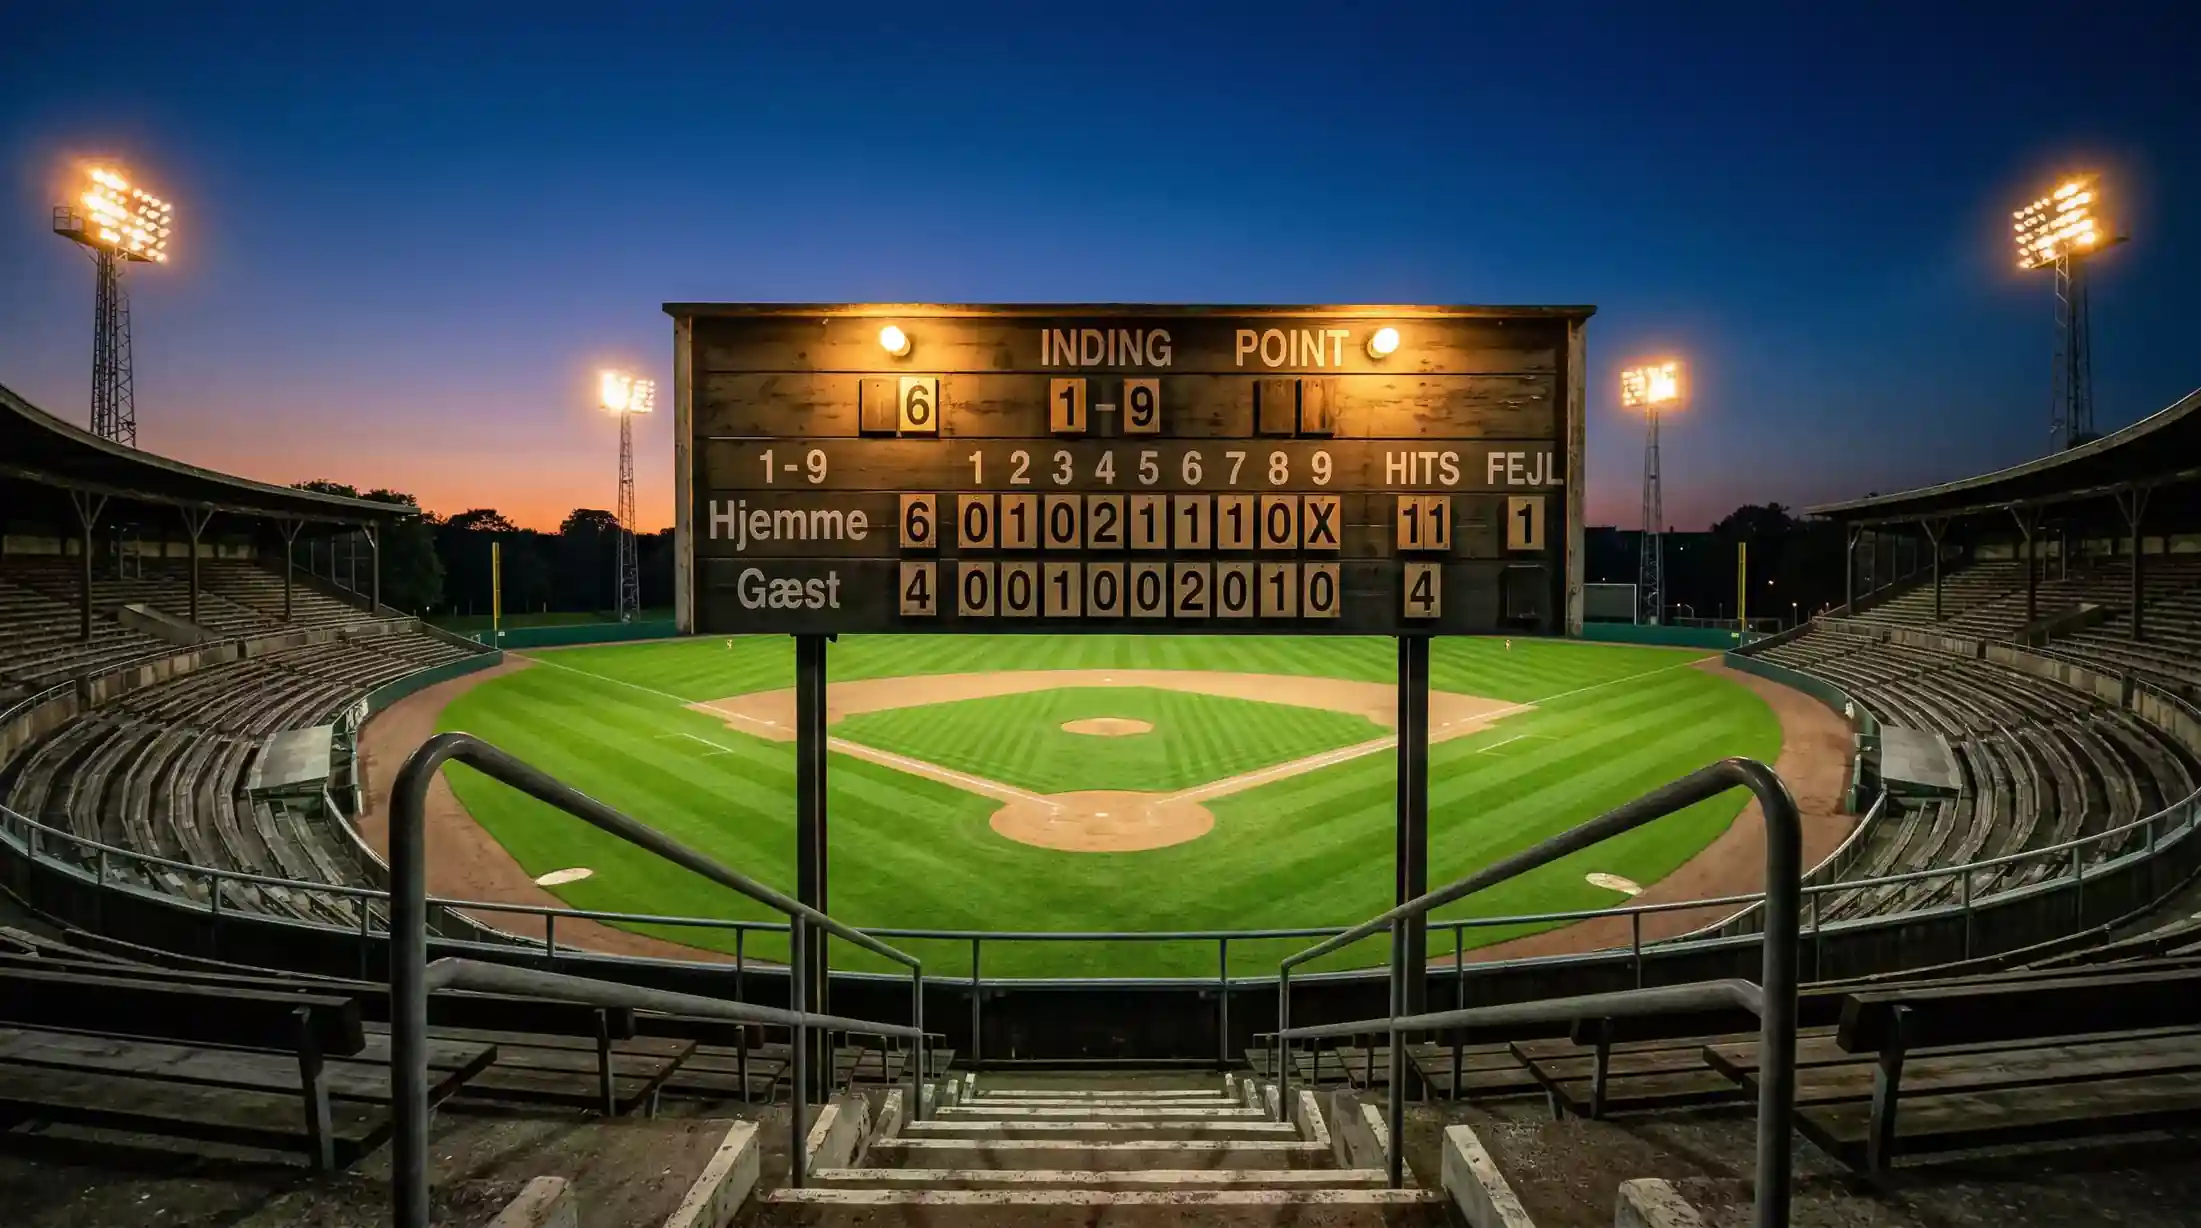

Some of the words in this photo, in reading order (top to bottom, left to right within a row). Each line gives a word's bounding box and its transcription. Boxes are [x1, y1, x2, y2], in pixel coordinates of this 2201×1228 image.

[1041, 329, 1171, 367] INDING
[1236, 329, 1349, 367] POINT
[907, 385, 929, 425] 6
[969, 451, 981, 483] 1
[1010, 450, 1030, 484] 2
[1052, 451, 1072, 484] 3
[1095, 451, 1115, 484] 4
[1139, 451, 1158, 484] 5
[1183, 451, 1202, 485] 6
[1226, 452, 1245, 484] 7
[1269, 451, 1288, 485] 8
[1312, 451, 1332, 485] 9
[1386, 452, 1459, 485] HITS
[1488, 452, 1564, 485] FEJL
[710, 500, 868, 550] Hjemme
[906, 502, 930, 542] 6
[1518, 504, 1532, 543] 1
[738, 568, 840, 609] Gæst
[906, 570, 930, 609] 4
[1410, 571, 1434, 611] 4
